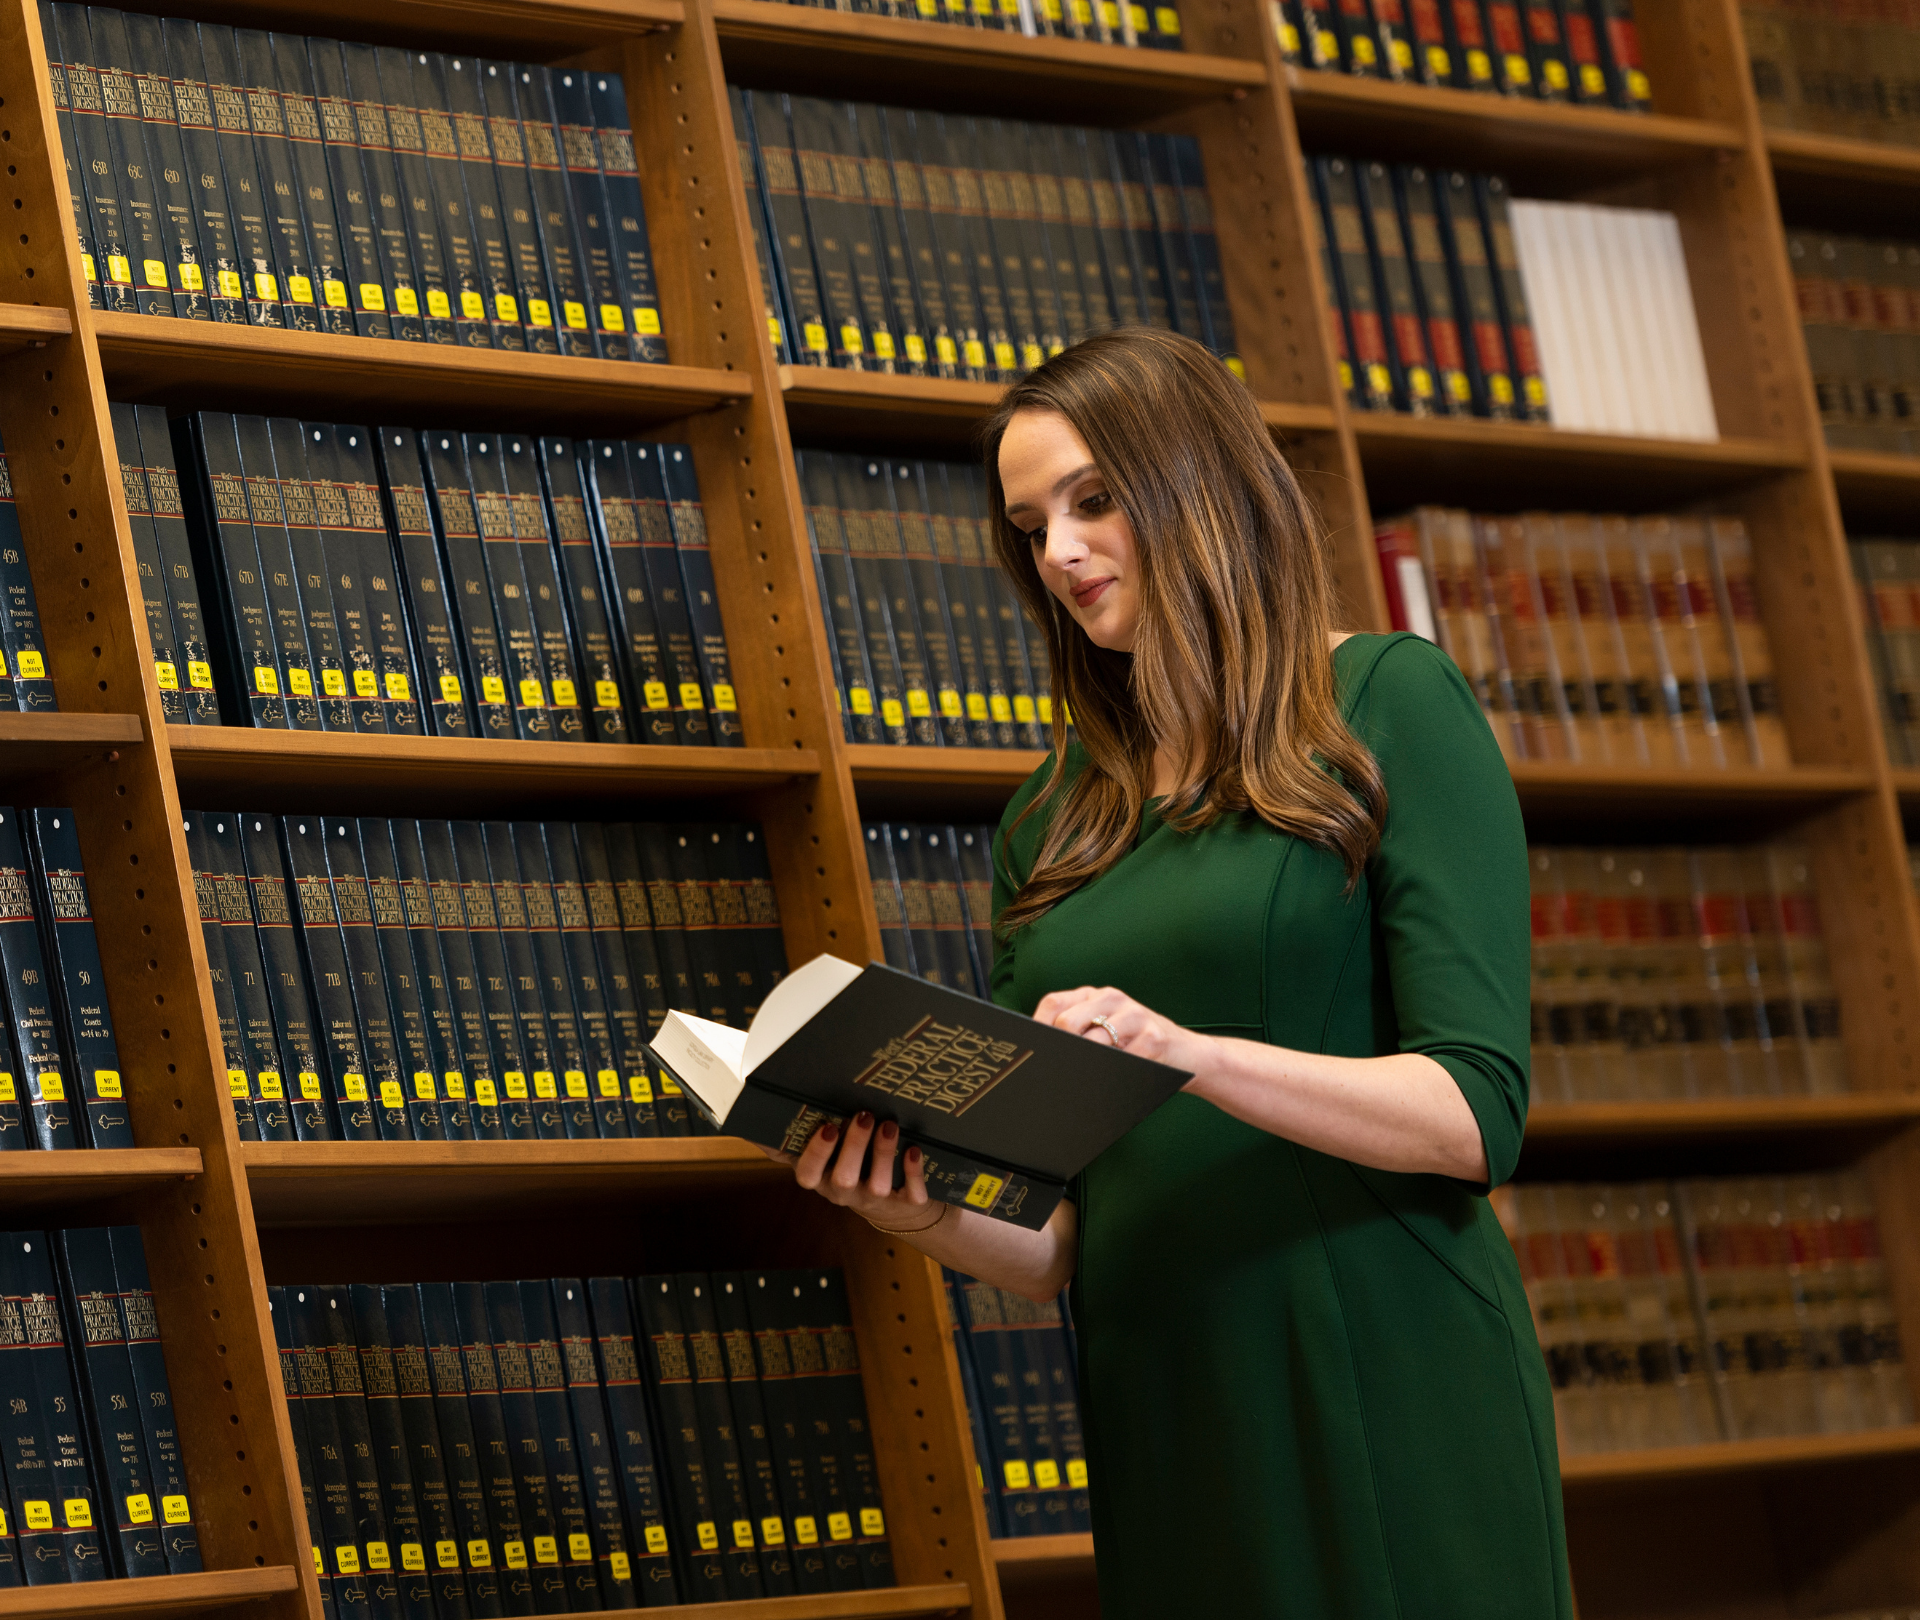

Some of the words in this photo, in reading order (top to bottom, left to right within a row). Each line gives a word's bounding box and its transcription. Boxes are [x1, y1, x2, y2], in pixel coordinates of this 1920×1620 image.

[101, 74, 133, 89] FEDERAL
[138, 79, 170, 94] FEDERAL
[103, 88, 136, 102] PRACTICE
[140, 92, 172, 106] PRACTICE
[174, 85, 208, 99] FEDERAL
[105, 101, 130, 114] DIGEST
[142, 106, 167, 118] DIGEST
[177, 98, 210, 112] PRACTICE
[179, 111, 204, 124] DIGEST
[92, 160, 108, 175] 63B
[128, 163, 143, 179] 63C
[164, 168, 180, 184] 63D
[201, 173, 216, 189] 63E
[240, 178, 250, 192] 64
[274, 181, 290, 195] 64A
[149, 473, 178, 487] FEDERAL
[213, 480, 244, 494] FEDERAL
[152, 487, 180, 500] PRACTICE
[216, 493, 246, 506] PRACTICE
[154, 500, 175, 513] DIGEST
[218, 506, 240, 519] DIGEST
[3, 549, 18, 564] 45B
[139, 562, 153, 576] 67A
[174, 564, 188, 578] 67B
[238, 570, 254, 584] 67D
[274, 572, 288, 586] 67E
[308, 572, 321, 588] 67F
[342, 574, 352, 589] 68
[372, 576, 388, 591] 68A
[9, 586, 26, 594] Federal
[50, 877, 82, 890] FEDERAL
[215, 881, 246, 893] FEDERAL
[53, 890, 85, 903] PRACTICE
[218, 894, 249, 907] PRACTICE
[55, 904, 79, 917] DIGEST
[220, 908, 244, 920] DIGEST
[22, 969, 38, 985] 49B
[79, 971, 90, 986] 50
[244, 972, 255, 986] 71
[281, 973, 296, 986] 71A
[325, 973, 340, 986] 71B
[362, 972, 377, 985] 71C
[400, 975, 409, 988] 72
[29, 1007, 45, 1015] Federal
[81, 1006, 101, 1014] Federal
[21, 1020, 34, 1028] Civil
[871, 1037, 907, 1060] West's
[865, 1022, 964, 1094] FEDERAL
[894, 1029, 993, 1104] PRACTICE
[924, 1057, 1000, 1113] DIGEST
[985, 1041, 1018, 1063] 4th
[945, 1173, 956, 1184] 715
[976, 1185, 984, 1196] NOT
[980, 1180, 997, 1205] CURRENT
[22, 1301, 58, 1316] FEDERAL
[81, 1300, 116, 1314] FEDERAL
[124, 1297, 154, 1311] FEDERAL
[24, 1315, 61, 1330] PRACTICE
[84, 1313, 119, 1328] PRACTICE
[127, 1310, 157, 1325] PRACTICE
[27, 1330, 55, 1344] DIGEST
[87, 1327, 114, 1342] DIGEST
[129, 1324, 152, 1339] DIGEST
[297, 1354, 327, 1366] FEDERAL
[300, 1367, 330, 1379] PRACTICE
[302, 1381, 324, 1393] DIGEST
[10, 1399, 27, 1414] 54B
[54, 1397, 66, 1412] 55
[111, 1395, 128, 1410] 55A
[150, 1392, 166, 1407] 55B
[18, 1437, 34, 1445] Federal
[57, 1434, 76, 1443] Federal
[117, 1432, 134, 1441] Federal
[156, 1430, 173, 1438] Federal
[61, 1447, 77, 1455] Courts
[322, 1445, 337, 1459] 76A
[355, 1442, 369, 1457] 76B
[391, 1446, 399, 1459] 77
[422, 1445, 436, 1458] 77A
[456, 1444, 470, 1457] 77B
[490, 1442, 505, 1455] 77C
[522, 1440, 538, 1453] 77D
[132, 1509, 150, 1517] CURRENT
